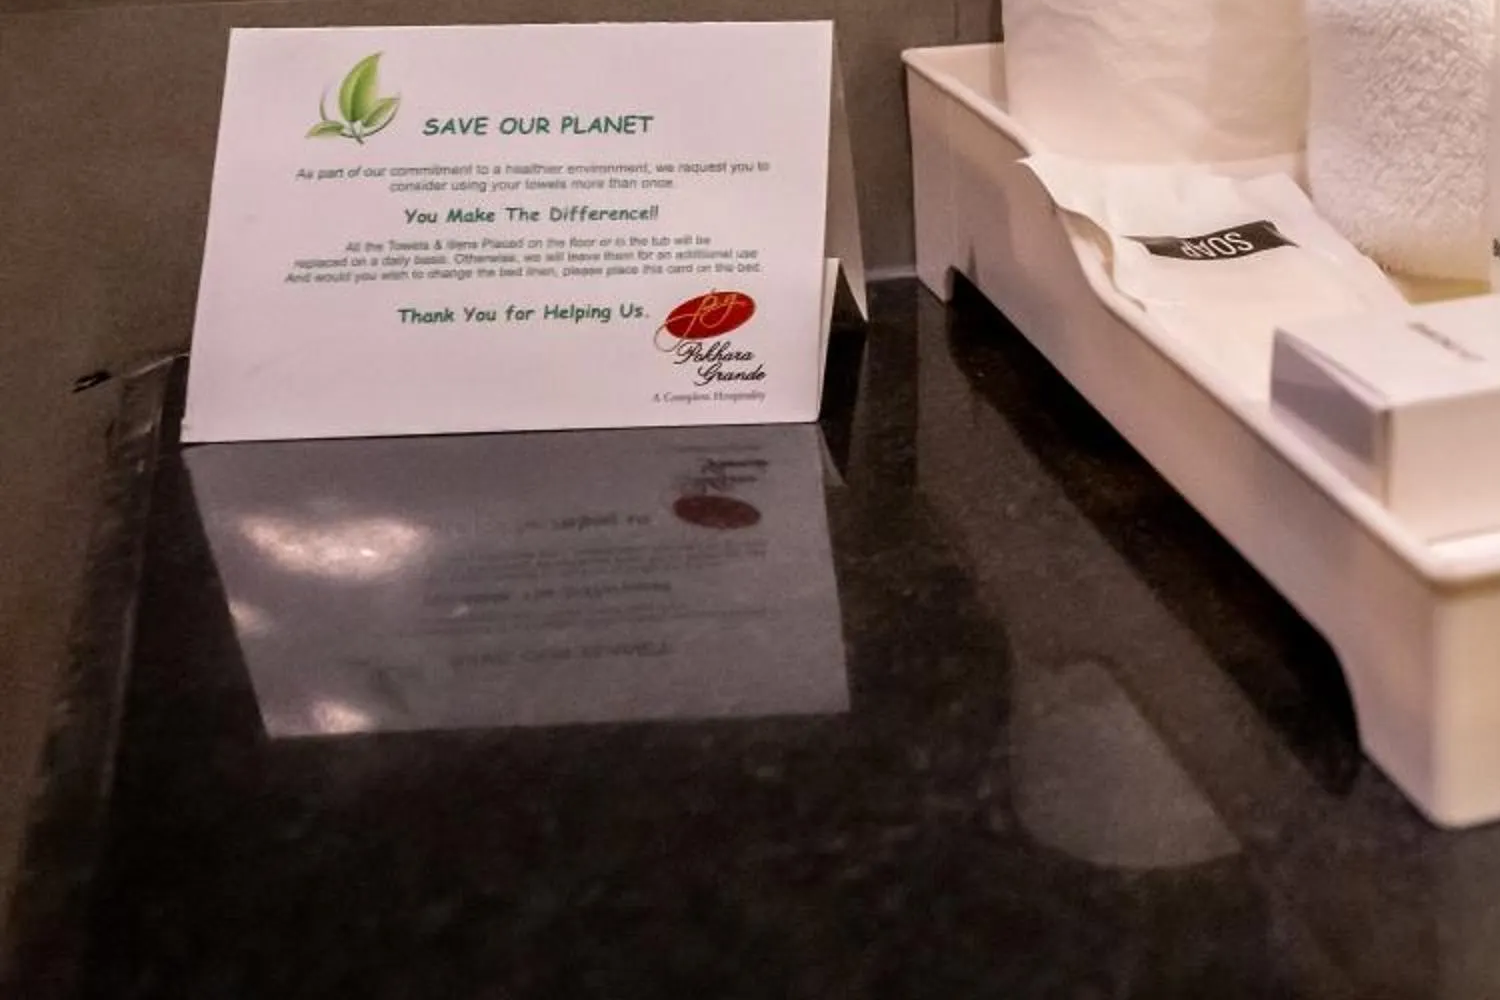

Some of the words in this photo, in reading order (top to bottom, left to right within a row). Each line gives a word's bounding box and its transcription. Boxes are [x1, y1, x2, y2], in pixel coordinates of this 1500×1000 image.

[423, 117, 489, 136] SAVE
[500, 116, 550, 136] OUR
[561, 115, 654, 135] PLANET
[296, 168, 313, 179] As
[317, 168, 343, 181] part
[347, 166, 362, 178] of
[363, 168, 386, 178] our
[390, 164, 472, 177] commitment
[476, 164, 489, 175] to
[492, 166, 500, 175] a
[506, 163, 563, 176] healthier
[656, 164, 674, 173] we
[678, 161, 727, 176] request
[730, 162, 753, 175] you
[758, 161, 770, 172] to
[390, 180, 447, 192] consider
[451, 180, 487, 194] using
[491, 181, 520, 193] your
[525, 178, 566, 190] towels
[571, 179, 604, 189] more
[609, 177, 637, 189] than
[404, 208, 438, 224] You
[446, 207, 495, 223] Make
[505, 207, 540, 222] The
[549, 205, 659, 222] Difference!!
[346, 241, 362, 251] All
[365, 241, 384, 251] the
[389, 240, 428, 251] Towels
[434, 240, 442, 250] &
[481, 238, 524, 249] Placed
[528, 239, 542, 248] on
[547, 238, 564, 248] the
[569, 236, 595, 247] floor
[599, 238, 612, 247] or
[629, 236, 648, 246] the
[651, 235, 670, 246] tub
[674, 235, 692, 245] will
[696, 235, 711, 245] be
[1179, 231, 1254, 259] SOAP
[293, 257, 347, 269] replaced
[351, 258, 367, 266] on
[370, 257, 378, 266] a
[381, 255, 410, 268] daily
[524, 254, 541, 263] we
[545, 252, 564, 262] will
[567, 252, 600, 262] leave
[603, 251, 634, 261] them
[637, 250, 653, 260] for
[656, 251, 672, 260] an
[675, 249, 732, 260] additional
[285, 272, 311, 283] And
[314, 270, 350, 282] would
[354, 271, 377, 284] you
[381, 269, 409, 280] wish
[412, 269, 424, 279] to
[427, 268, 472, 281] change
[477, 267, 496, 277] the
[499, 266, 522, 277] bed
[562, 265, 603, 277] please
[605, 264, 638, 276] place
[642, 264, 663, 274] this
[666, 263, 693, 273] card
[696, 264, 711, 272] on
[715, 263, 734, 273] the
[398, 308, 455, 324] Thank
[463, 306, 497, 323] You
[505, 305, 535, 321] for
[544, 303, 612, 323] Helping
[619, 303, 649, 320] Us.
[673, 341, 756, 366] Pokhara
[694, 363, 768, 387] Grande
[653, 393, 662, 402] A
